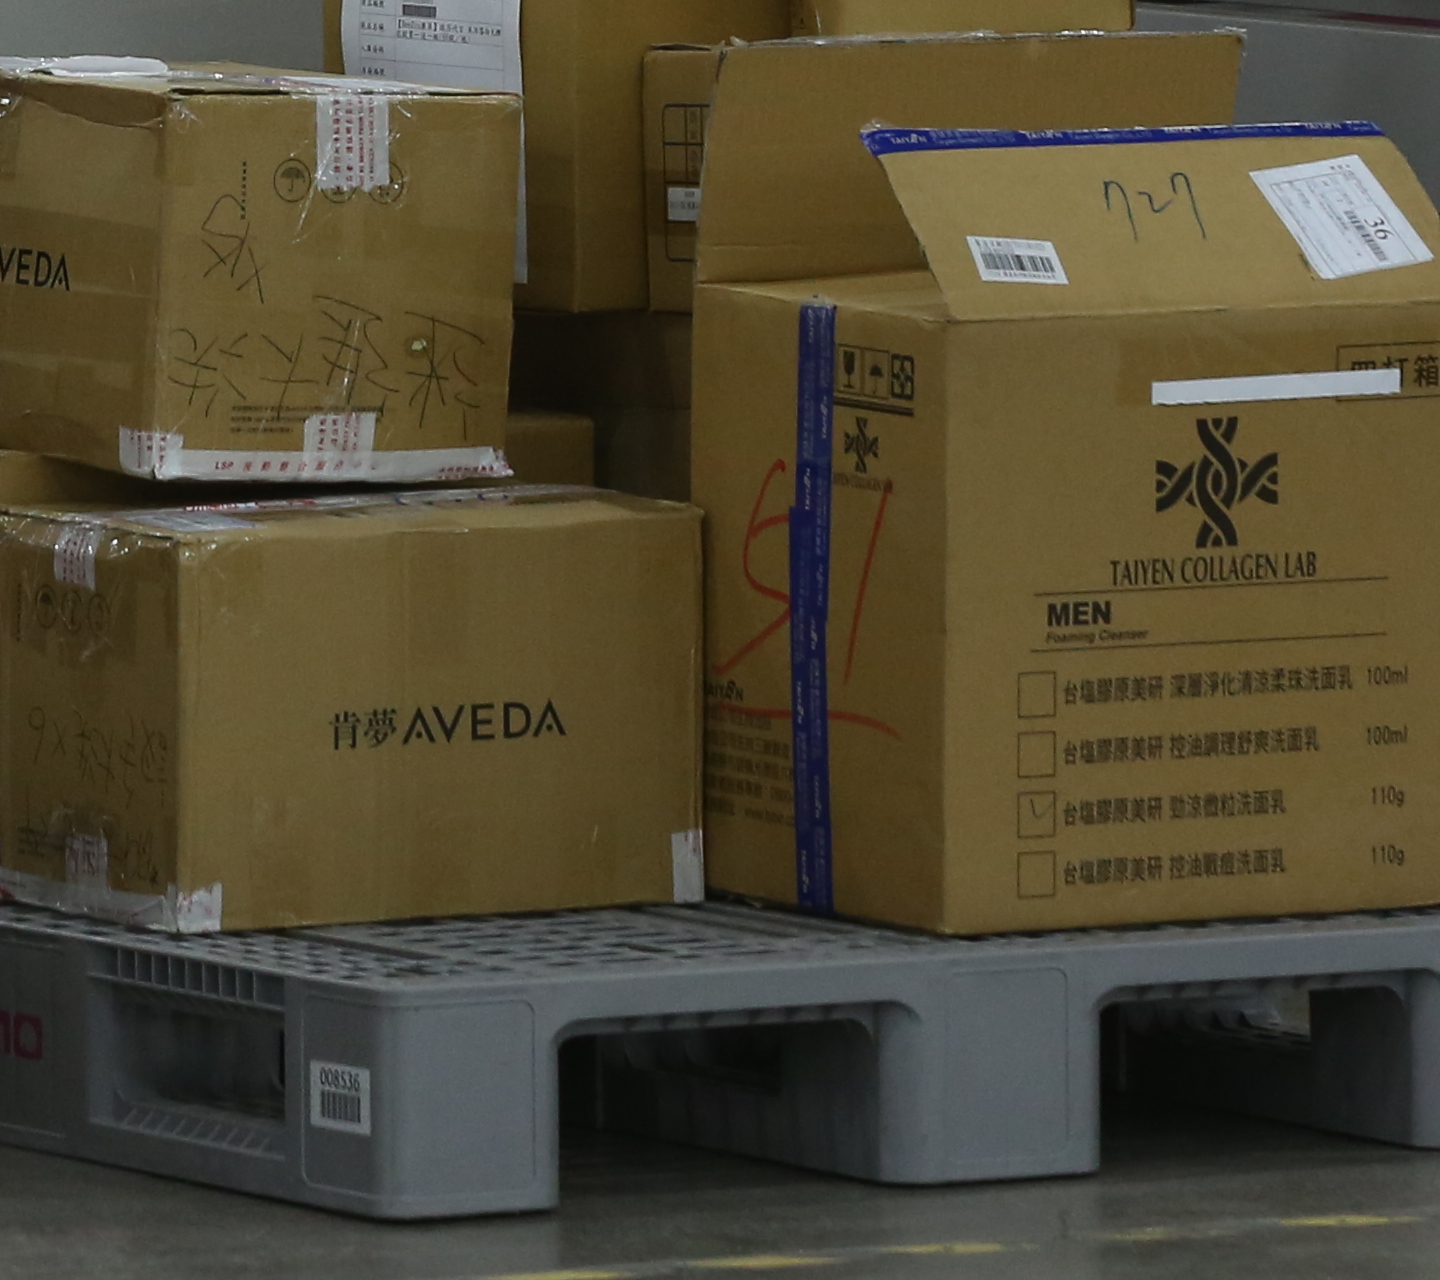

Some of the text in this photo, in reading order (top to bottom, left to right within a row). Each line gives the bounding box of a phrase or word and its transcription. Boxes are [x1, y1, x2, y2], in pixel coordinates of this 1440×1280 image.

[1363, 215, 1395, 241] 36
[1109, 551, 1317, 587] TAIYEN COLLAGEN LAB
[1046, 600, 1111, 627] MEN
[1366, 665, 1409, 686] 100ml
[402, 699, 567, 745] AVEDA
[1366, 725, 1409, 746] 100ml
[1370, 786, 1405, 808] 110g
[1371, 845, 1406, 866] 110g
